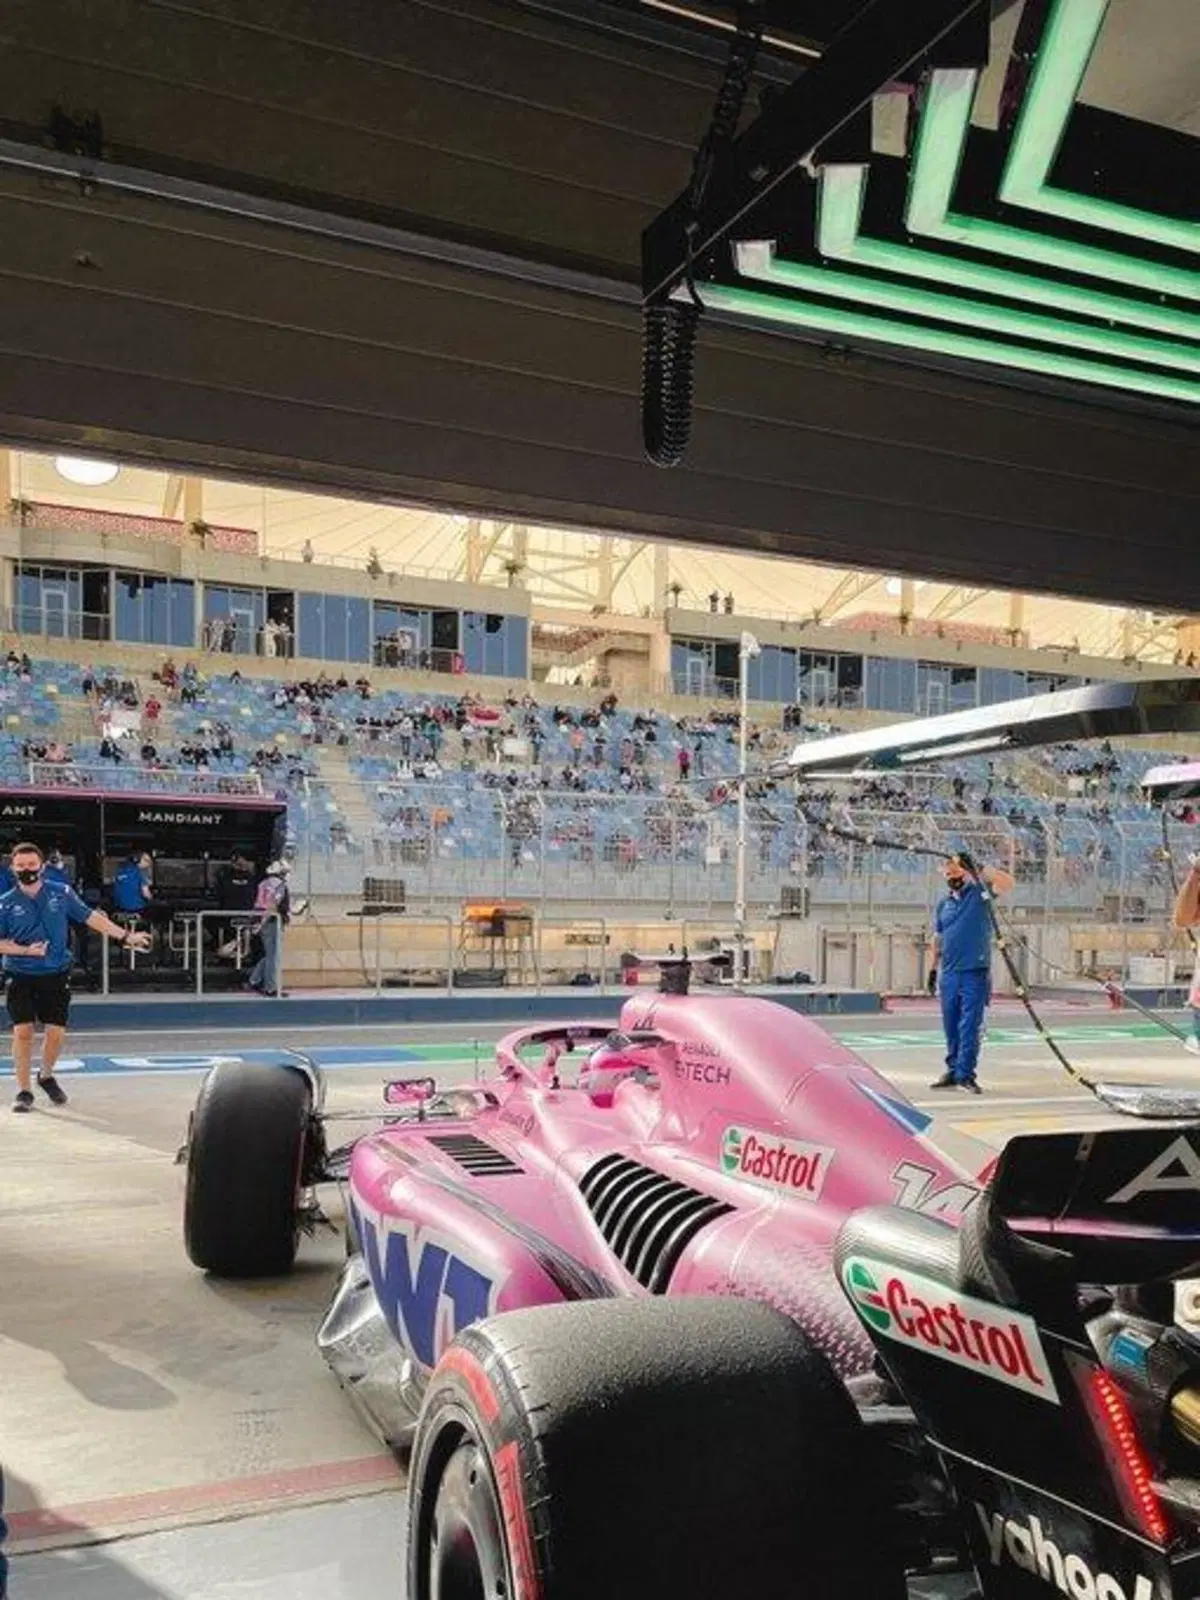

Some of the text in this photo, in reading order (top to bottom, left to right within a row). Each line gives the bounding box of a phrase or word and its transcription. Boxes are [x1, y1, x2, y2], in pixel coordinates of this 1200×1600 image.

[138, 811, 222, 825] MANDIANT
[741, 1136, 821, 1191] Castrol
[893, 1161, 980, 1214] 14
[886, 1278, 1044, 1387] Castrol
